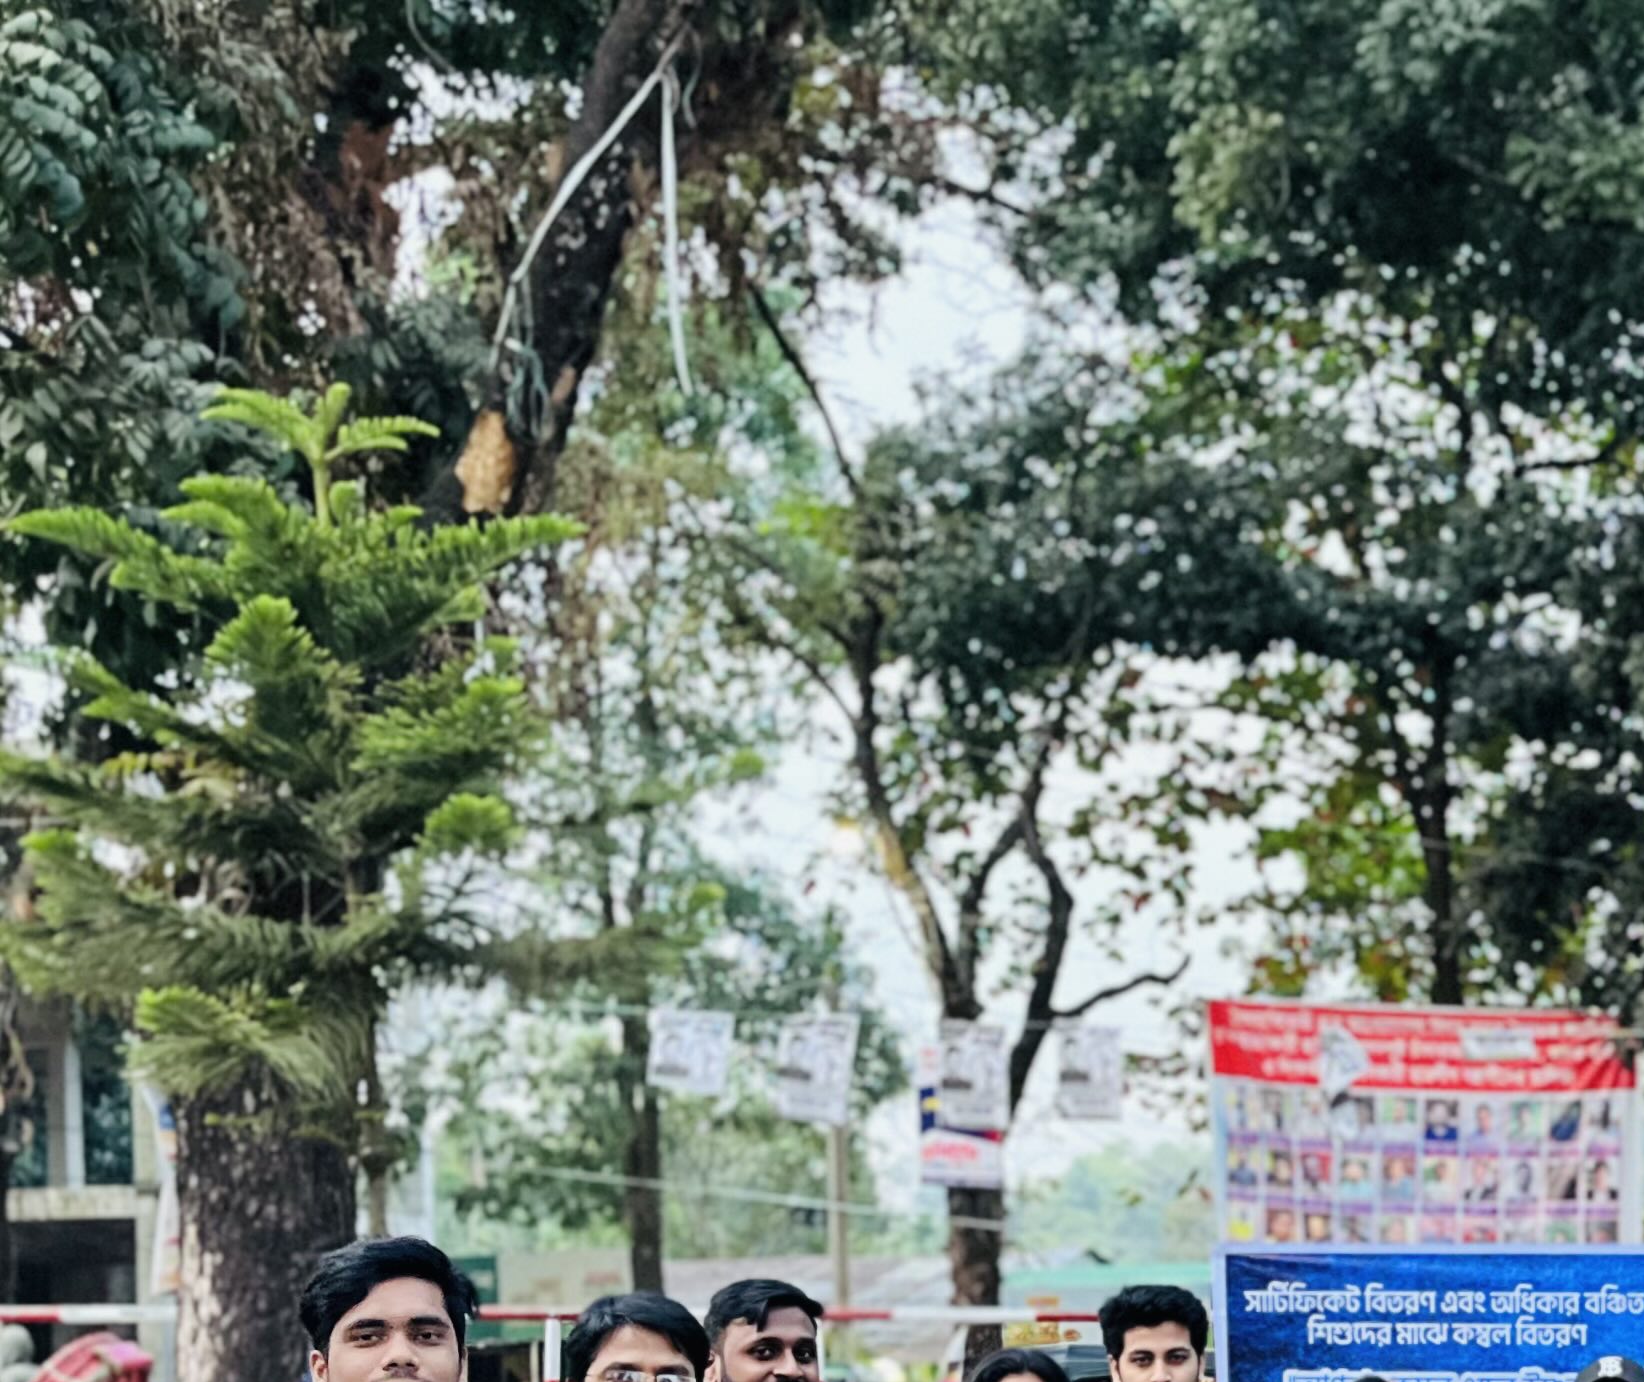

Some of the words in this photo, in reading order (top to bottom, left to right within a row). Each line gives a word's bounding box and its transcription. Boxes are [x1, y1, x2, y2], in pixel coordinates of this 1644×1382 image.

[1243, 1280, 1361, 1313] সার্টিফিকেট
[1364, 1282, 1436, 1315] বিতরণ
[1440, 1290, 1486, 1314] এবং
[1489, 1283, 1580, 1316] অধিকার
[1307, 1314, 1393, 1348] শিশুদের
[1395, 1321, 1449, 1346] মাঝে
[1451, 1323, 1511, 1348] কম্বল
[1515, 1315, 1588, 1348] বিতরণ
